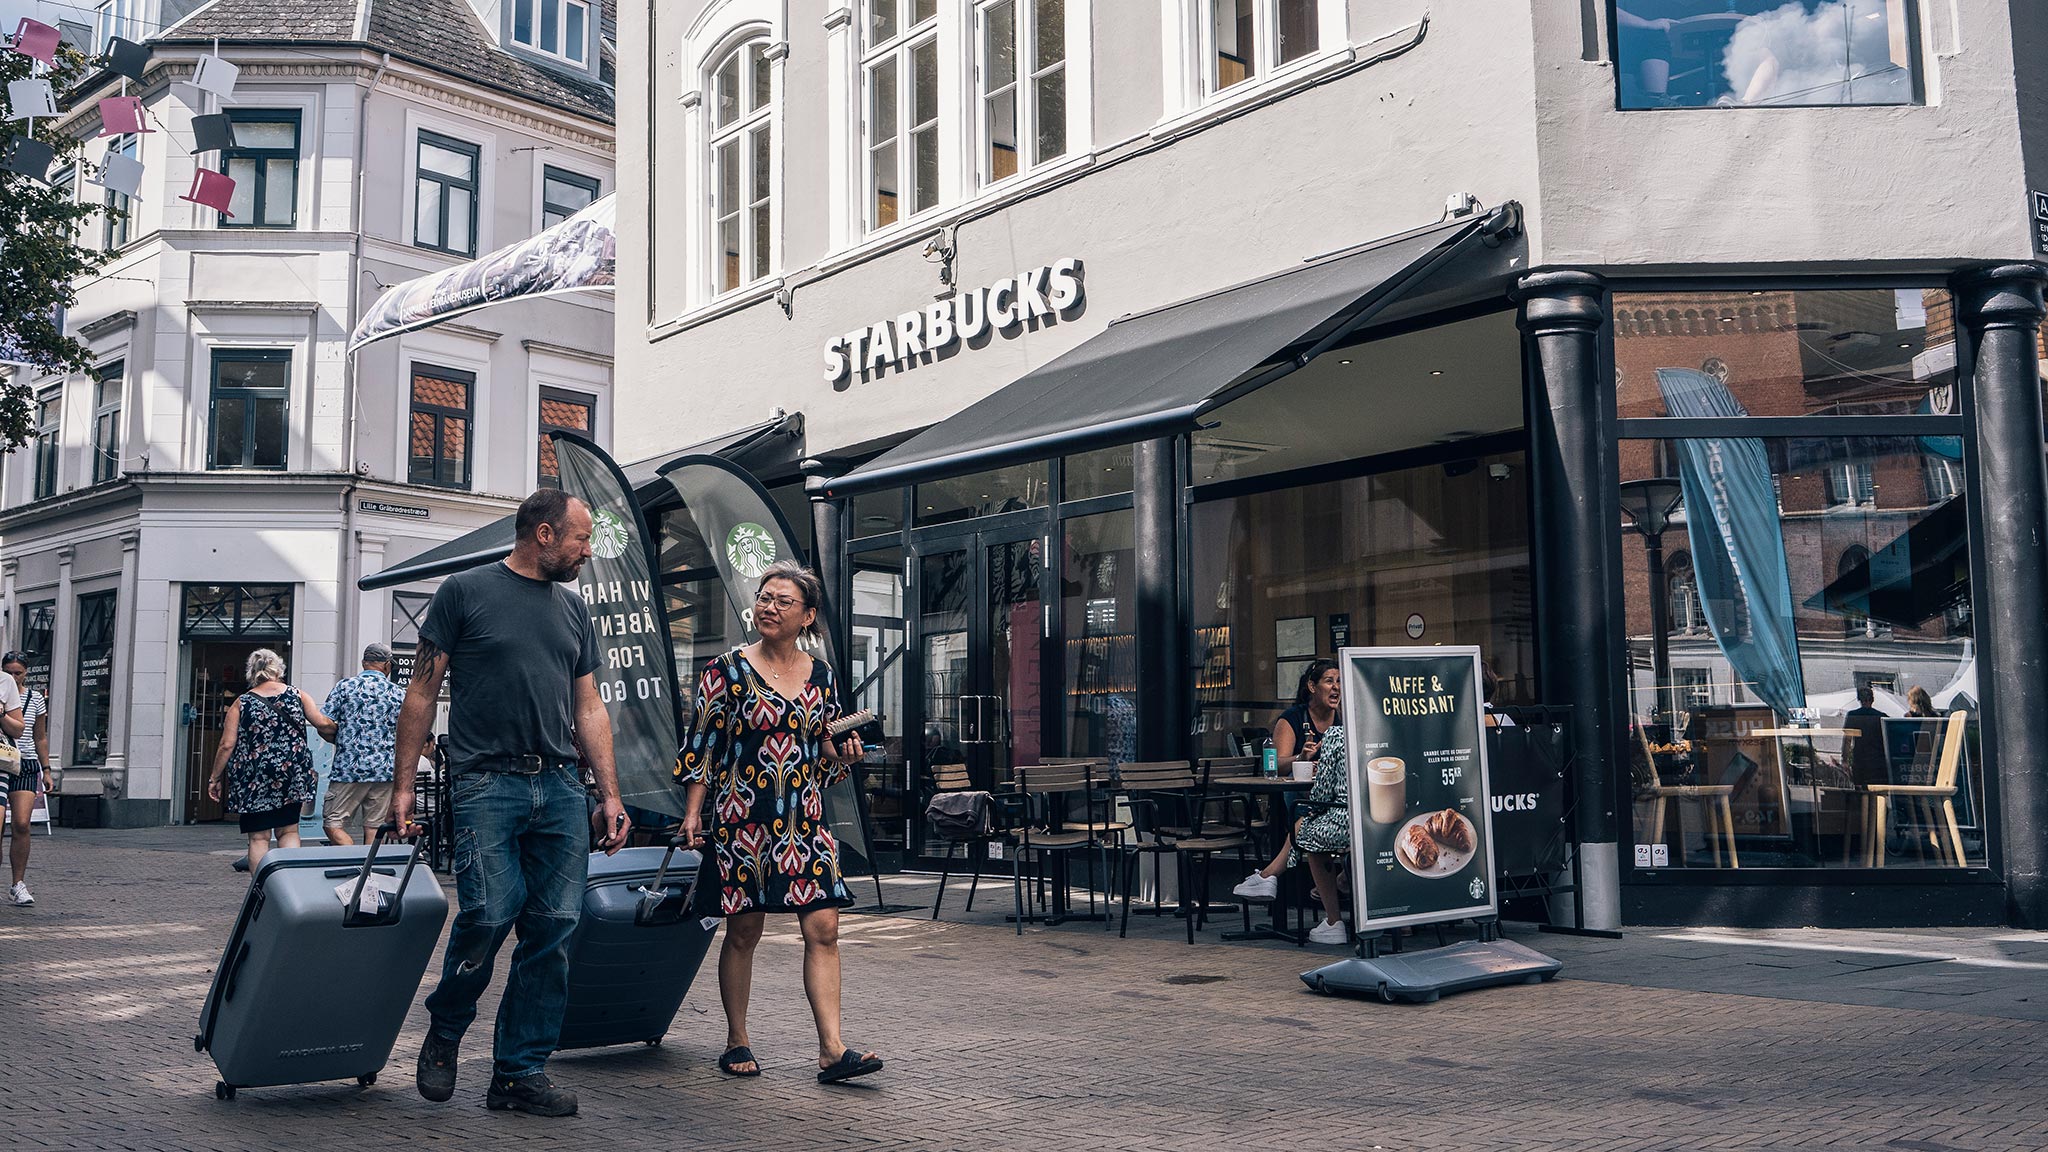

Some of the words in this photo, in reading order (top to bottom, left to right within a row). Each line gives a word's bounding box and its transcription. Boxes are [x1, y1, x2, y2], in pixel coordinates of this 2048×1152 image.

[823, 257, 1083, 383] STARBUCKS
[362, 502, 377, 510] Lille
[379, 503, 427, 516] Gråbrødrestræde
[398, 658, 410, 666] DO
[397, 677, 407, 685] AS
[1388, 675, 1425, 694] KAFFE
[1430, 675, 1444, 692] &
[1382, 694, 1454, 715] CROISSANT
[1491, 793, 1537, 813] UCKS
